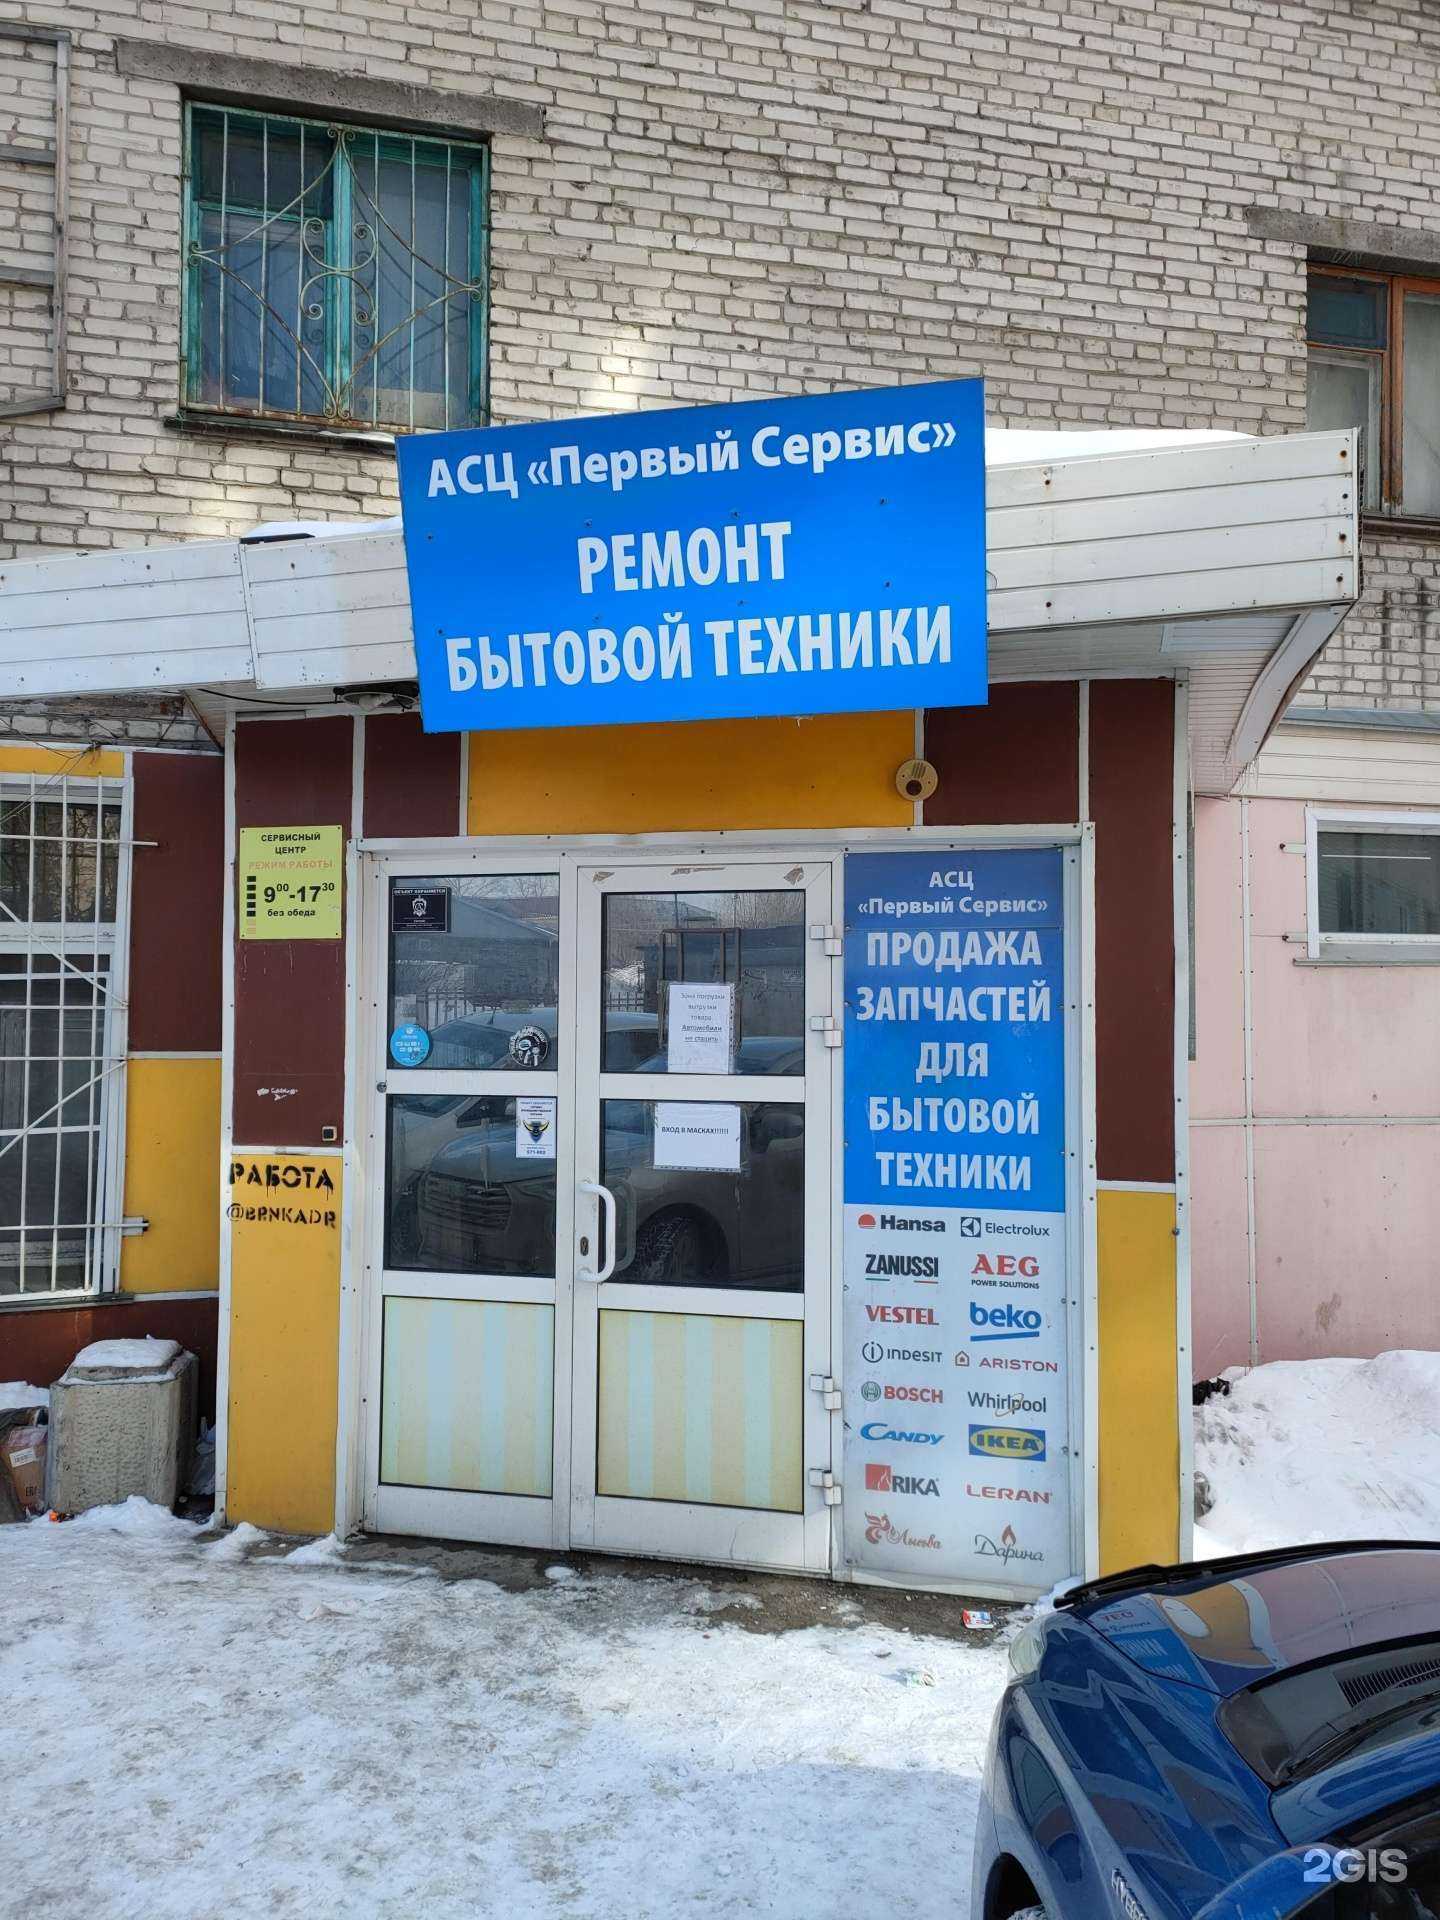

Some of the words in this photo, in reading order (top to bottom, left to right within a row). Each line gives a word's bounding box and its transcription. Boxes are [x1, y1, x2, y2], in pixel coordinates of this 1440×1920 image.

[427, 451, 519, 499] АСЦ
[527, 429, 740, 490] «Первый
[751, 420, 957, 473] Сервис»
[577, 521, 792, 594] РЕМОНТ
[446, 611, 693, 692] БЫТОВОЙ
[705, 605, 952, 676] ТЕХНИКИ
[261, 832, 321, 842] СЕРВИСНЫЙ
[275, 846, 307, 855] ЦЕНТР
[248, 861, 287, 870] РЕЖИМ
[929, 871, 974, 891] АСЦ
[267, 909, 285, 917] без
[287, 909, 316, 917] обеда
[858, 896, 953, 918] «Первый
[959, 897, 1048, 917] Сервис»
[867, 930, 1042, 972] ПРОДАЖА
[856, 979, 1051, 1022] ЗАПЧАСТЕЙ
[915, 1042, 988, 1083] ДЛЯ
[869, 1092, 1040, 1135] БЫТОВОЙ
[662, 1126, 680, 1134] ВХОД
[229, 1163, 334, 1190] РАБОТА
[875, 1151, 1031, 1191] ТЕХНИКИ
[880, 1214, 946, 1233] Hansa
[985, 1222, 1050, 1237] Electrolux
[865, 1253, 939, 1277] ZANUSSI
[971, 1253, 1040, 1277] AEG
[971, 1279, 997, 1288] POWER
[999, 1280, 1040, 1289] SOLUTIONS
[865, 1305, 940, 1325] VESTEL
[970, 1302, 1042, 1329] beko
[979, 1357, 1058, 1373] ARISTON
[884, 1385, 944, 1403] BOSCH
[968, 1391, 1047, 1414] Whirlpool
[975, 1433, 1041, 1452] IKEA
[891, 1475, 940, 1497] RIKA
[967, 1484, 1050, 1504] LERAN
[974, 1533, 1044, 1565] Дарина
